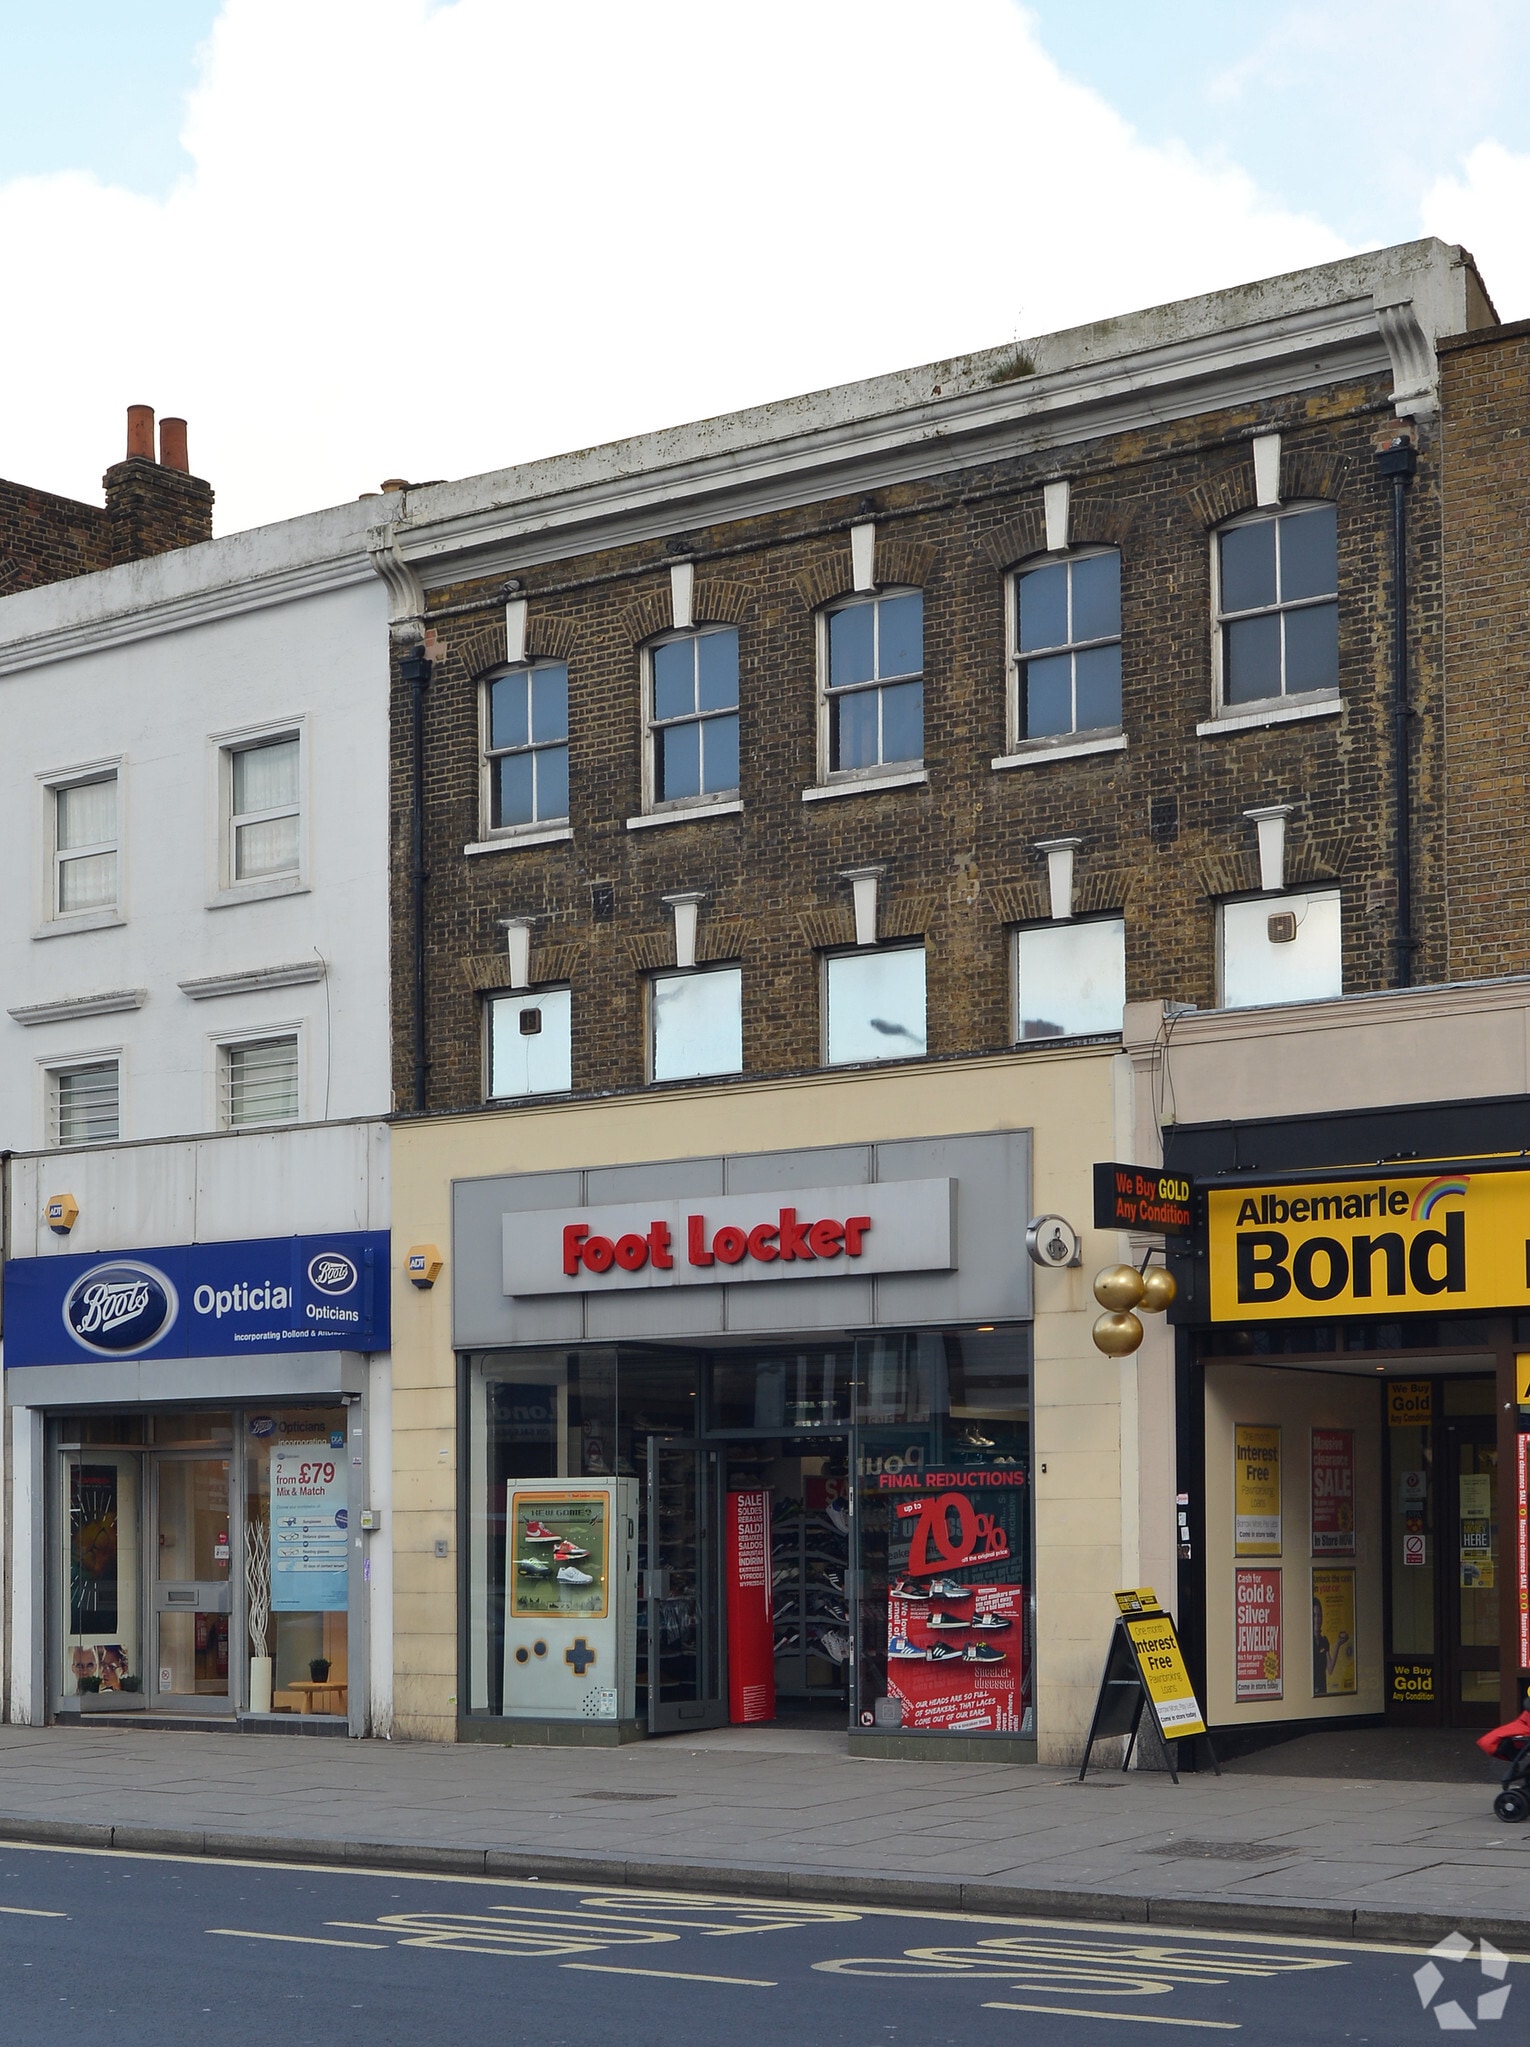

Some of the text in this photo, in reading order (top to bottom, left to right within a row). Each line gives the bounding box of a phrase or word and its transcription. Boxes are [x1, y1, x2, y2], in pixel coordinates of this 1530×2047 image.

[1116, 1173, 1190, 1201] We Buy GOLD
[1116, 1198, 1190, 1225] Any Condition
[1236, 1186, 1409, 1226] Albemarle
[563, 1208, 871, 1276] Foot Locker
[409, 1258, 424, 1269] ADT
[1237, 1211, 1466, 1304] Bond
[315, 1261, 348, 1285] Boots
[76, 1280, 149, 1334] Boots
[306, 1304, 359, 1321] Opticians
[310, 1329, 316, 1337] &
[1392, 1384, 1430, 1394] We Buy
[1392, 1396, 1430, 1411] Gold
[278, 1420, 326, 1433] Opticians
[1313, 1437, 1343, 1449] Massive
[1237, 1445, 1278, 1461] Interest
[1313, 1453, 1348, 1466] clearance
[276, 1464, 282, 1474] 2
[1247, 1465, 1270, 1481] Free
[276, 1475, 297, 1485] from
[879, 1471, 1024, 1488] FINAL REDUCTIONS
[1313, 1468, 1351, 1497] SALE
[276, 1487, 325, 1497] Mix & Match
[737, 1495, 762, 1507] SALE
[904, 1502, 922, 1513] up to
[737, 1507, 762, 1516] SOLDES
[738, 1523, 763, 1534] SALDI
[897, 1492, 1008, 1576] 70%
[738, 1541, 763, 1550] SALDOS
[1314, 1535, 1321, 1546] In
[1322, 1535, 1338, 1546] Store
[1464, 1534, 1487, 1546] HERE
[969, 1554, 977, 1562] the
[977, 1551, 995, 1561] original
[995, 1550, 1008, 1558] price
[1237, 1574, 1262, 1583] Cash for
[1237, 1585, 1275, 1603] Gold &
[901, 1602, 908, 1616] We
[1237, 1605, 1270, 1624] Silver
[894, 1627, 901, 1637] of
[1135, 1624, 1165, 1636] One month
[1237, 1626, 1279, 1652] JEWELLERY
[1148, 1656, 1173, 1671] Free
[975, 1666, 1011, 1678] Sneaker
[1394, 1666, 1432, 1676] We Buy
[975, 1677, 1016, 1690] obsessed
[1149, 1671, 1183, 1685] Pawnbroking
[1394, 1677, 1432, 1691] Gold
[1161, 1684, 1178, 1694] Loans
[1267, 1683, 1279, 1691] today
[915, 1690, 989, 1709] OUR HEADS ARE SO FULL
[1392, 1691, 1434, 1701] Any Condition
[914, 1709, 923, 1718] OF
[959, 1701, 976, 1711] THAT
[976, 1697, 996, 1707] LACES
[914, 1708, 986, 1727] COME OUT OF OUR EARS
[961, 1720, 978, 1728] sneaker
[978, 1718, 990, 1726] thing
[323, 1897, 1354, 1996] BUS STOP
